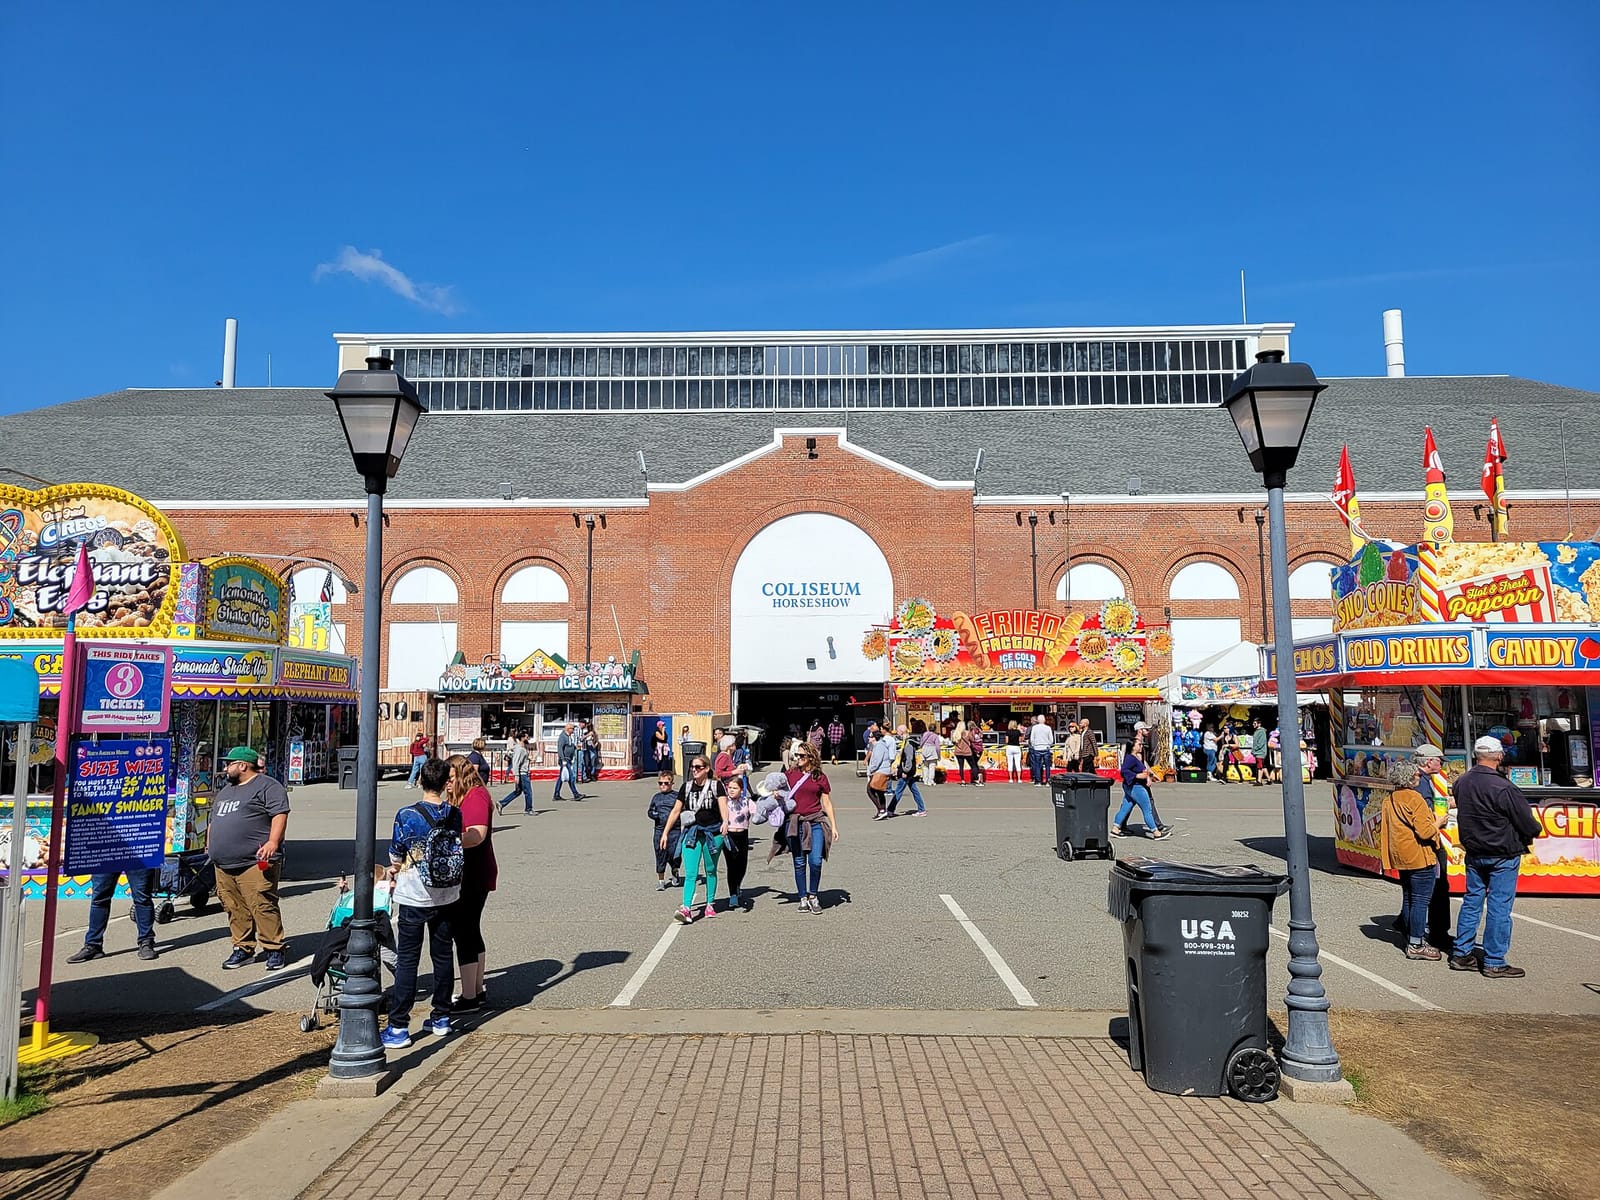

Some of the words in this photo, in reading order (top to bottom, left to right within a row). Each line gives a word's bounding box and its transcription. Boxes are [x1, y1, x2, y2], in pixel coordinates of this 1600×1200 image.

[220, 584, 271, 608] Lemonade
[762, 583, 861, 596] COLISEUM
[1468, 586, 1488, 599] Hot
[1489, 585, 1497, 594] &
[1500, 577, 1528, 592] Fresh
[772, 598, 851, 608] HORSESHOW
[1337, 589, 1364, 628] SNO
[1367, 582, 1414, 616] CONES
[1448, 587, 1542, 620] Popcorn
[217, 604, 250, 624] Shake
[250, 611, 271, 630] Ups
[974, 610, 1062, 640] FRIED
[288, 614, 328, 651] sh
[981, 636, 1055, 654] FACTORY
[1347, 640, 1386, 667] COLD
[1388, 637, 1471, 665] DRINKS
[1490, 639, 1578, 666] CANDY
[113, 652, 133, 660] RIDE
[135, 653, 160, 661] TAKES
[999, 653, 1013, 663] ICE
[1015, 652, 1036, 662] COLD
[1003, 661, 1034, 670] DRINKS
[222, 657, 251, 676] Shake
[251, 657, 267, 681] Ups
[283, 661, 328, 682] ELEPHANT
[328, 668, 348, 683] EARS
[113, 664, 135, 696] 3
[439, 676, 514, 691] MOO-NUTS
[560, 676, 580, 689] ICE
[584, 675, 632, 689] CREAM
[100, 699, 144, 709] TICKETS
[80, 760, 119, 777] SIZE
[125, 758, 164, 774] WIZE
[124, 775, 143, 786] 36"
[145, 774, 166, 785] MIN
[121, 786, 140, 798] 54"
[142, 785, 166, 796] MAX
[71, 802, 113, 816] FAMILY
[115, 798, 164, 814] SWINGER
[216, 800, 240, 816] Lite
[1181, 920, 1236, 940] USA
[1184, 942, 1235, 950] 800-998-2984
